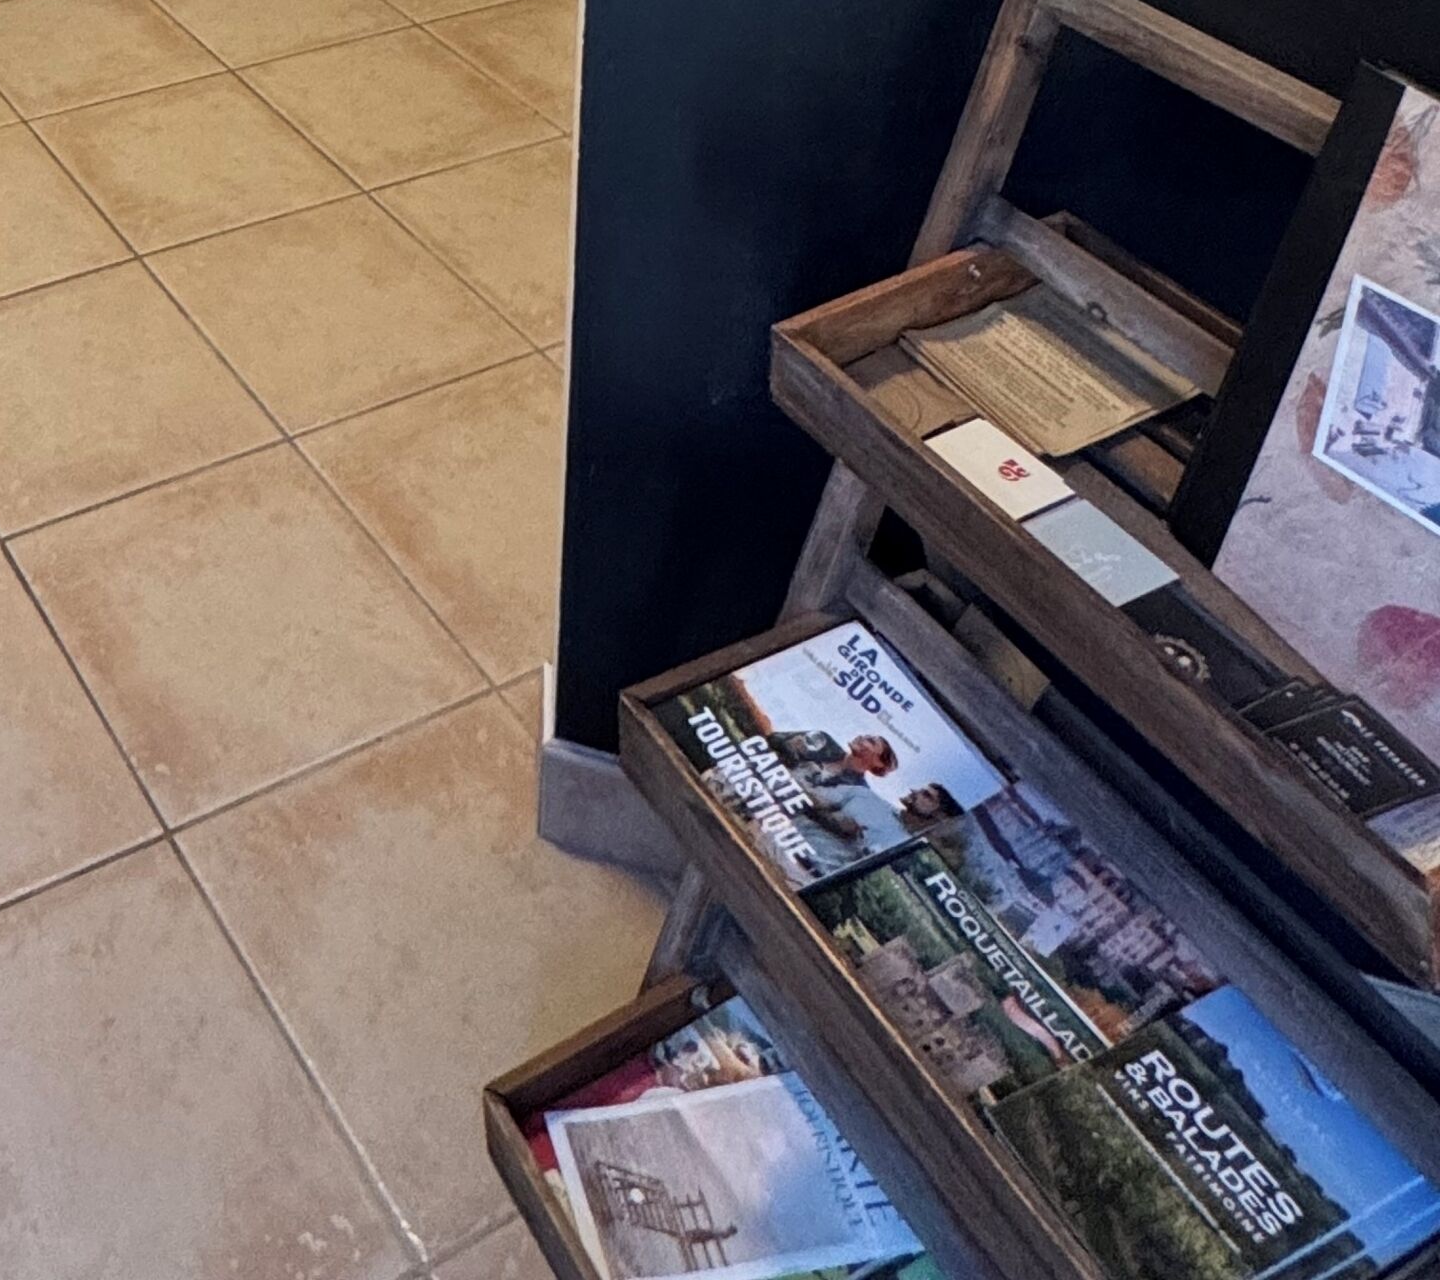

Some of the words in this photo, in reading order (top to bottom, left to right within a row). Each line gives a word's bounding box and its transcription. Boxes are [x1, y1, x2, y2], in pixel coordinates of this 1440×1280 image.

[837, 645, 915, 714] GIRONDE
[846, 634, 877, 668] LA
[832, 670, 882, 716] SUD
[687, 705, 817, 866] TOURISTIQUE
[740, 735, 815, 816] CARTE
[1113, 1069, 1150, 1110] VINS
[1124, 1062, 1148, 1087] &
[1146, 1086, 1283, 1237] BALADES
[1140, 1049, 1304, 1226] ROUTES
